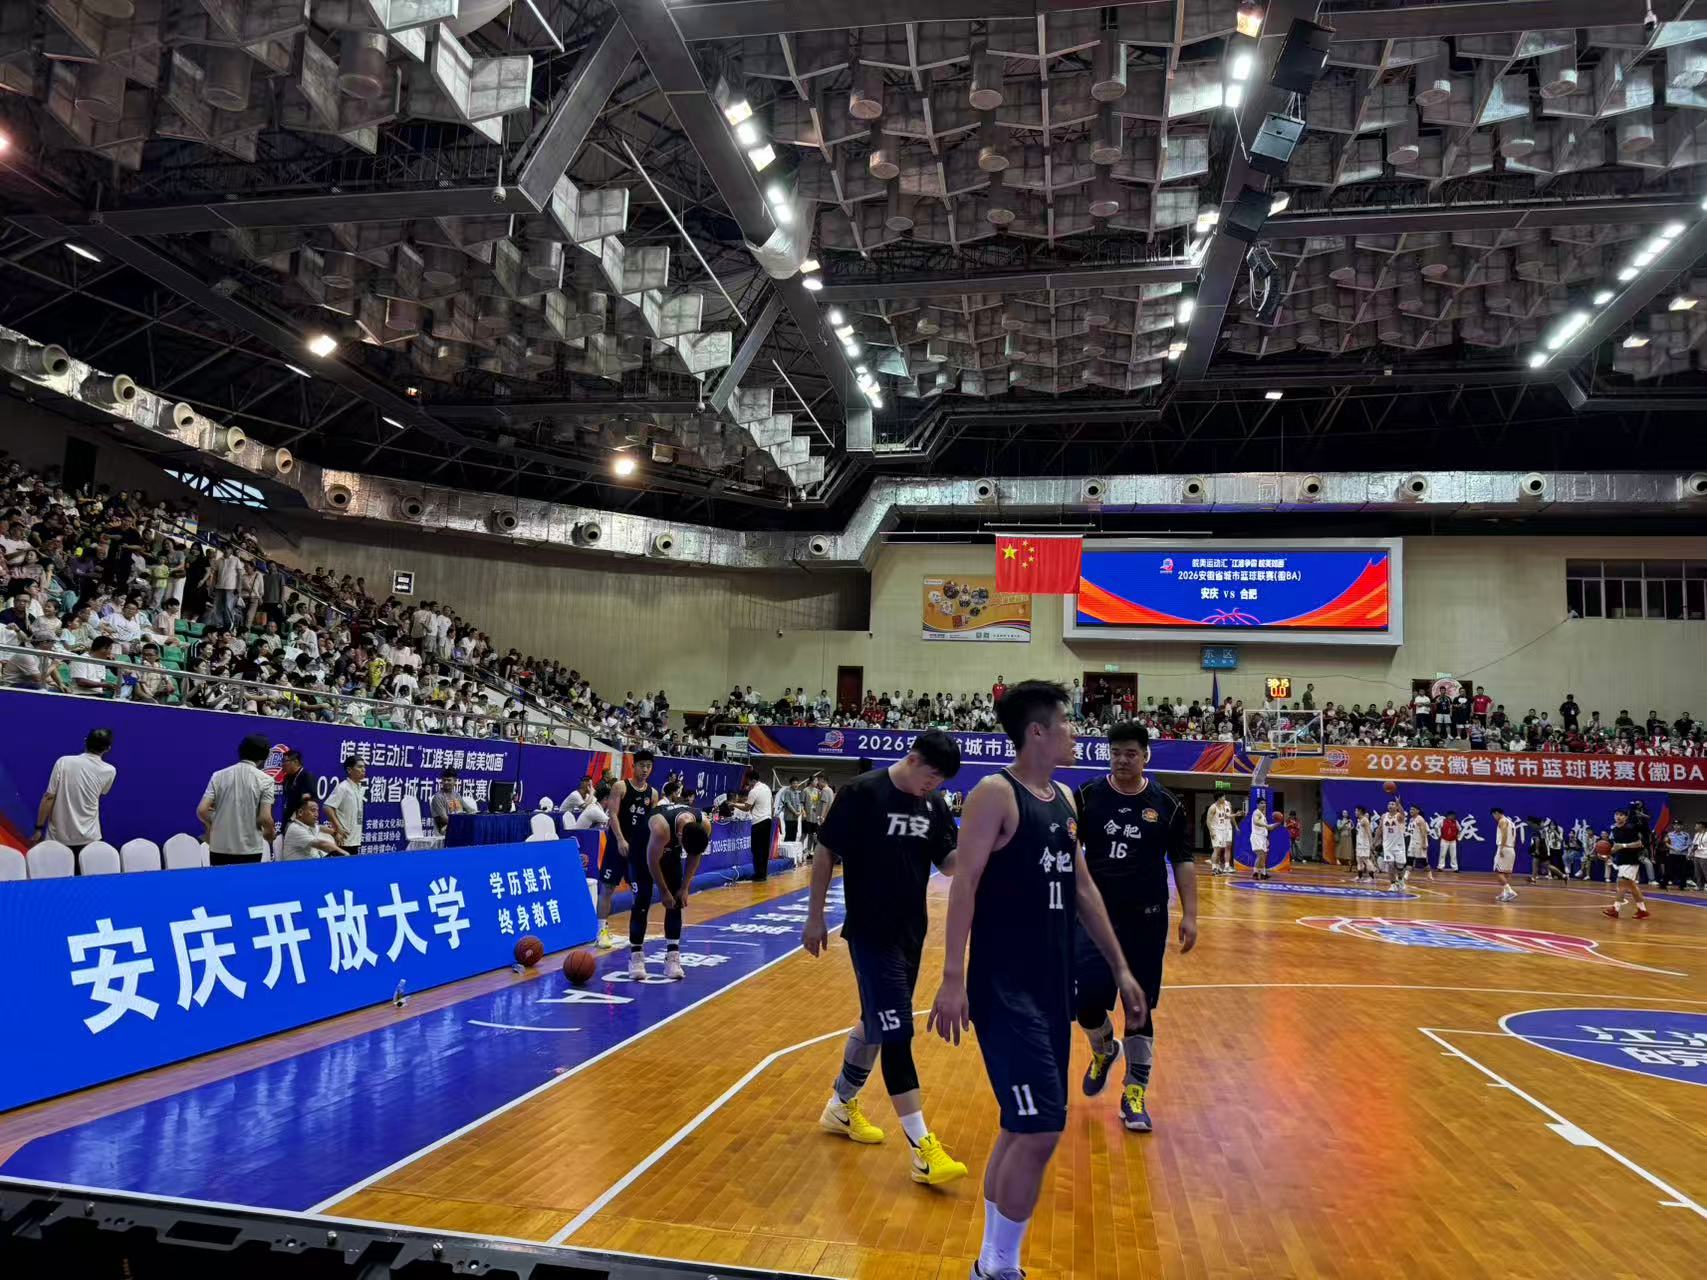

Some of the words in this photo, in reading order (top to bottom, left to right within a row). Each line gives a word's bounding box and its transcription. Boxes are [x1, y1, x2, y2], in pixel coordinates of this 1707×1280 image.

[1201, 588, 1219, 599] 安庆
[1240, 588, 1258, 600] 合肥
[1366, 753, 1705, 784] 2026安徽省城市篮球联赛(徽BA
[632, 815, 638, 826] 5
[886, 813, 930, 840] 万安
[1104, 819, 1142, 840] 合肥
[1039, 846, 1074, 873] 合肥
[1109, 841, 1128, 859] 16
[489, 865, 552, 900] 学历提升
[604, 868, 612, 879] 5
[1048, 881, 1063, 910] 11
[498, 898, 561, 935] 终身教育
[66, 876, 471, 1034] 安庆开放大学
[878, 1009, 900, 1032] 15
[1011, 1084, 1038, 1116] 11
